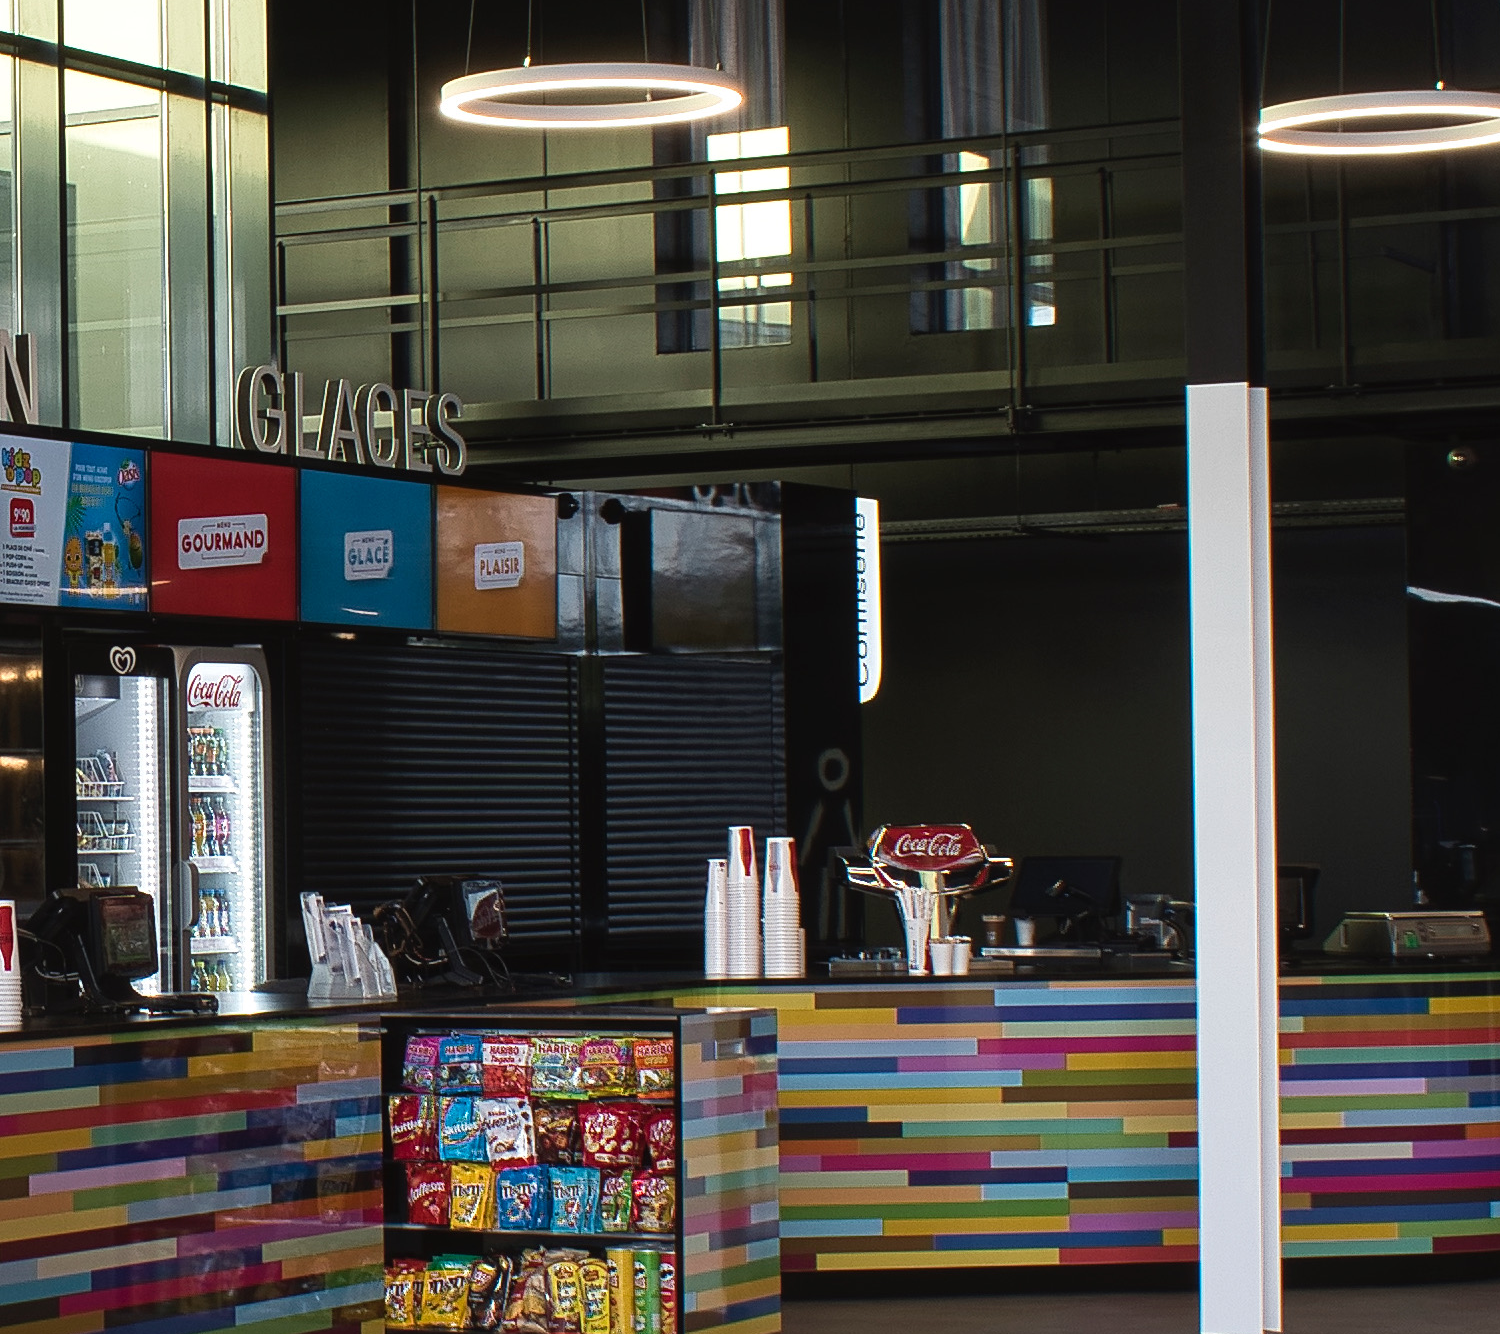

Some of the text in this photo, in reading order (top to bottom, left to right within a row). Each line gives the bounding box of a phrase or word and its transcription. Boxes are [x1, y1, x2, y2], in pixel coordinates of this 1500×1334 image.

[236, 364, 468, 476] GLACES
[181, 529, 265, 553] GOURMAND
[348, 539, 390, 566] GLACÉ
[480, 557, 520, 577] PLAISIR
[188, 673, 243, 709] Coca-Cola
[894, 832, 963, 857] Coca-Cola
